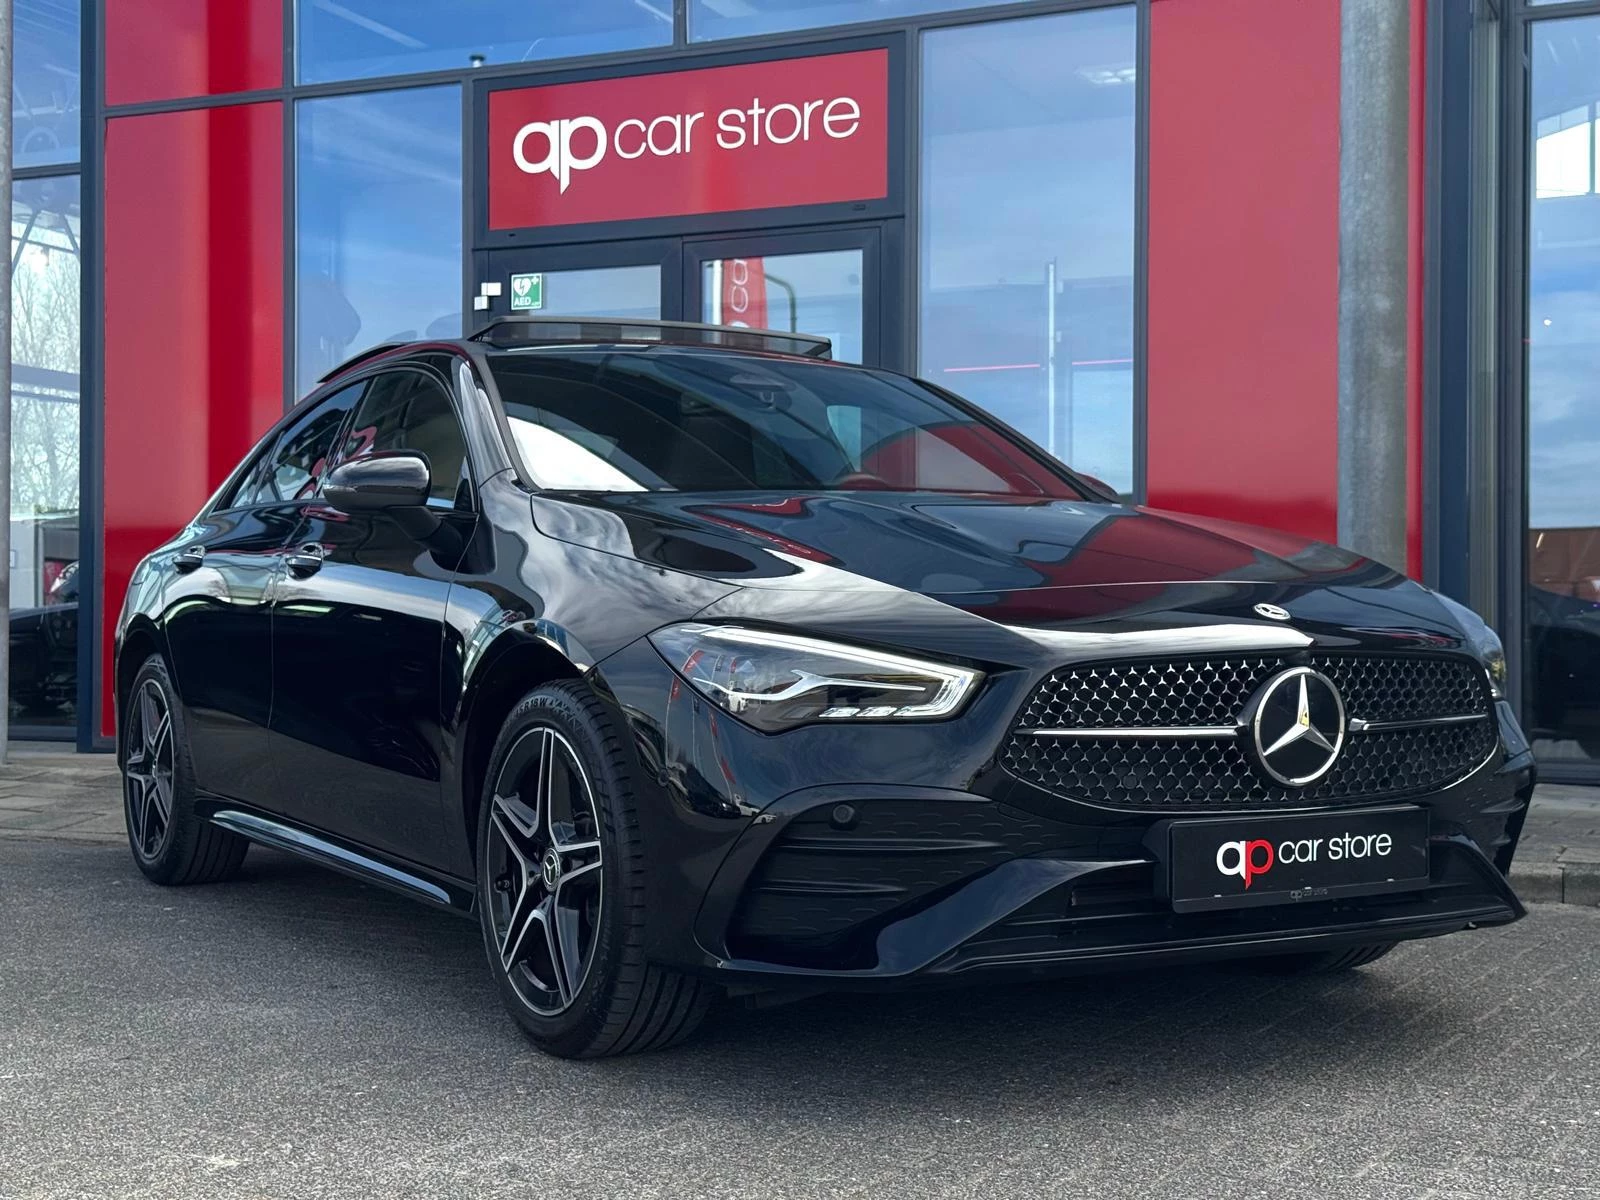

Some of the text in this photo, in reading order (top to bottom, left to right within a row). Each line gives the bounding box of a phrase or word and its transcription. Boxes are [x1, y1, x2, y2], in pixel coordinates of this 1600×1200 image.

[513, 97, 860, 195] ap car store
[514, 297, 531, 306] AED
[1216, 832, 1392, 890] ap car store
